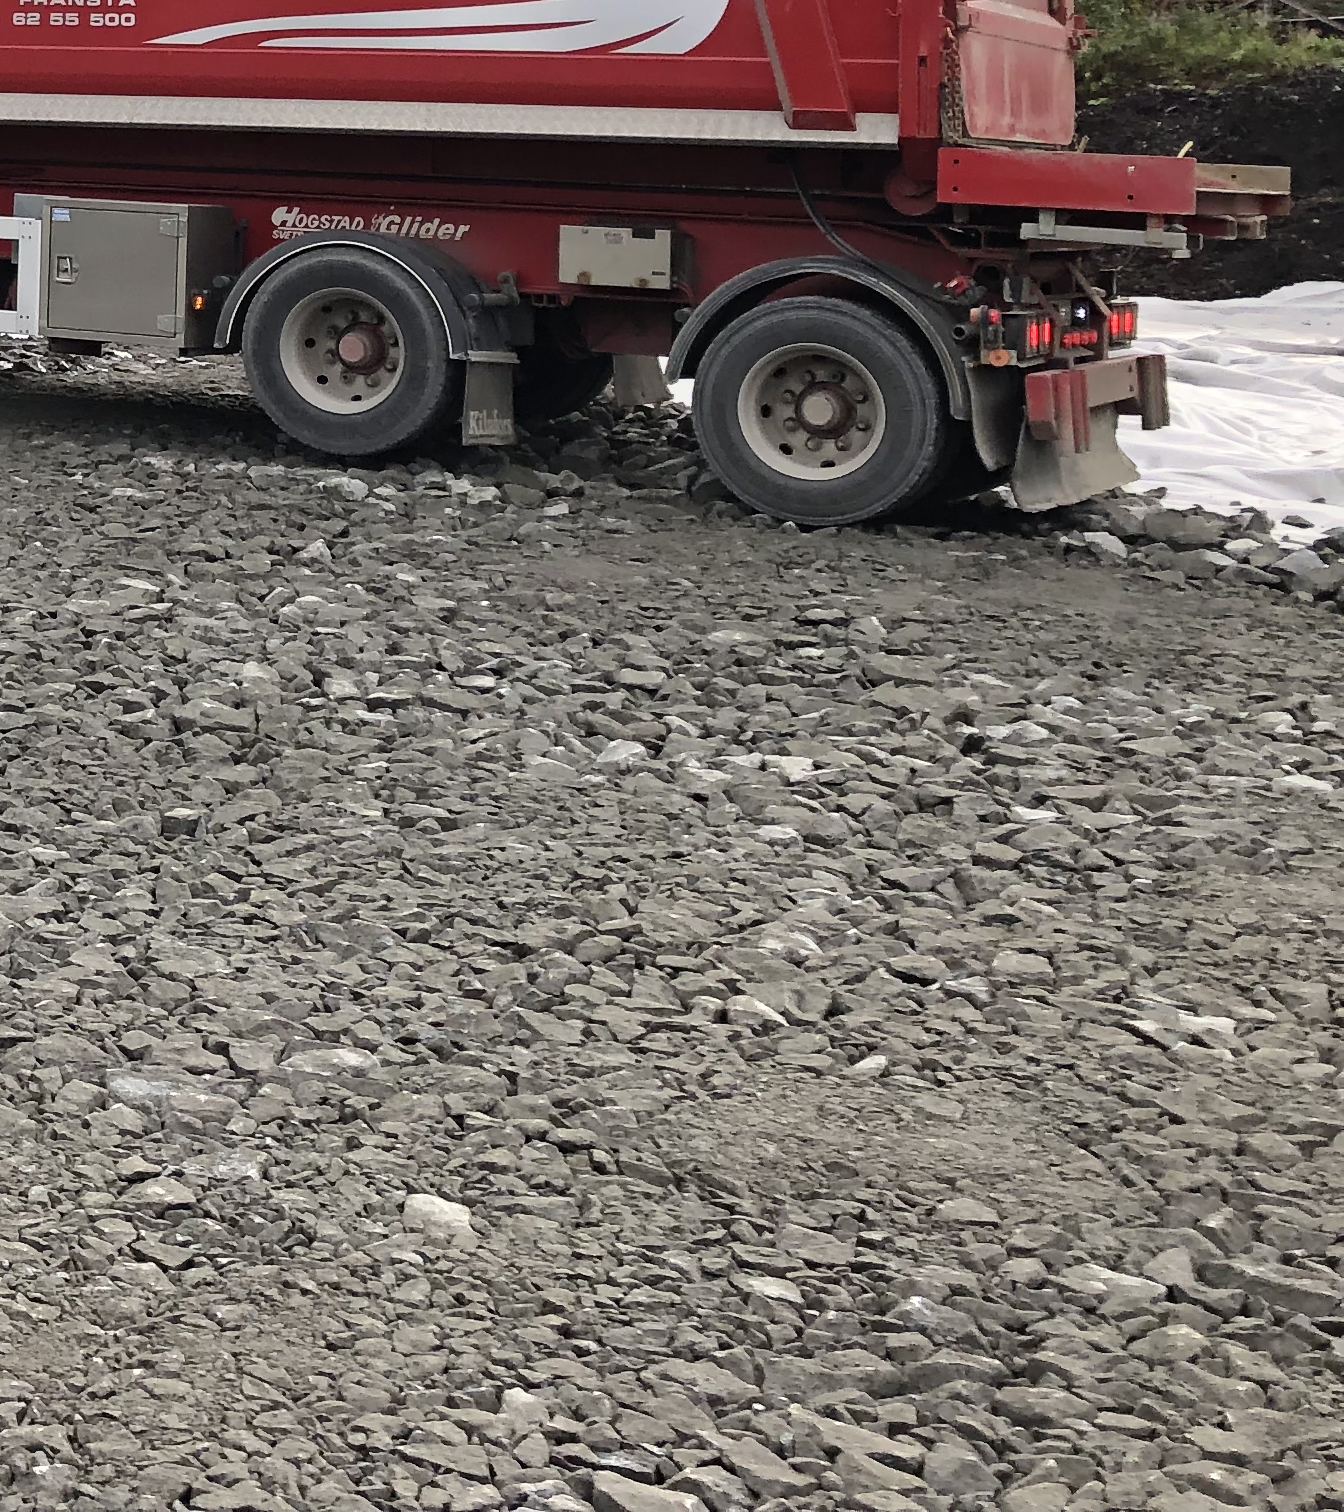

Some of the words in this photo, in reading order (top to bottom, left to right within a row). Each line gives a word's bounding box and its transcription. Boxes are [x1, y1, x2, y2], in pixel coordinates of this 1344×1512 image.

[12, 12, 41, 26] 62
[49, 12, 80, 26] 55
[89, 13, 137, 27] 500
[379, 213, 471, 241] Glider
